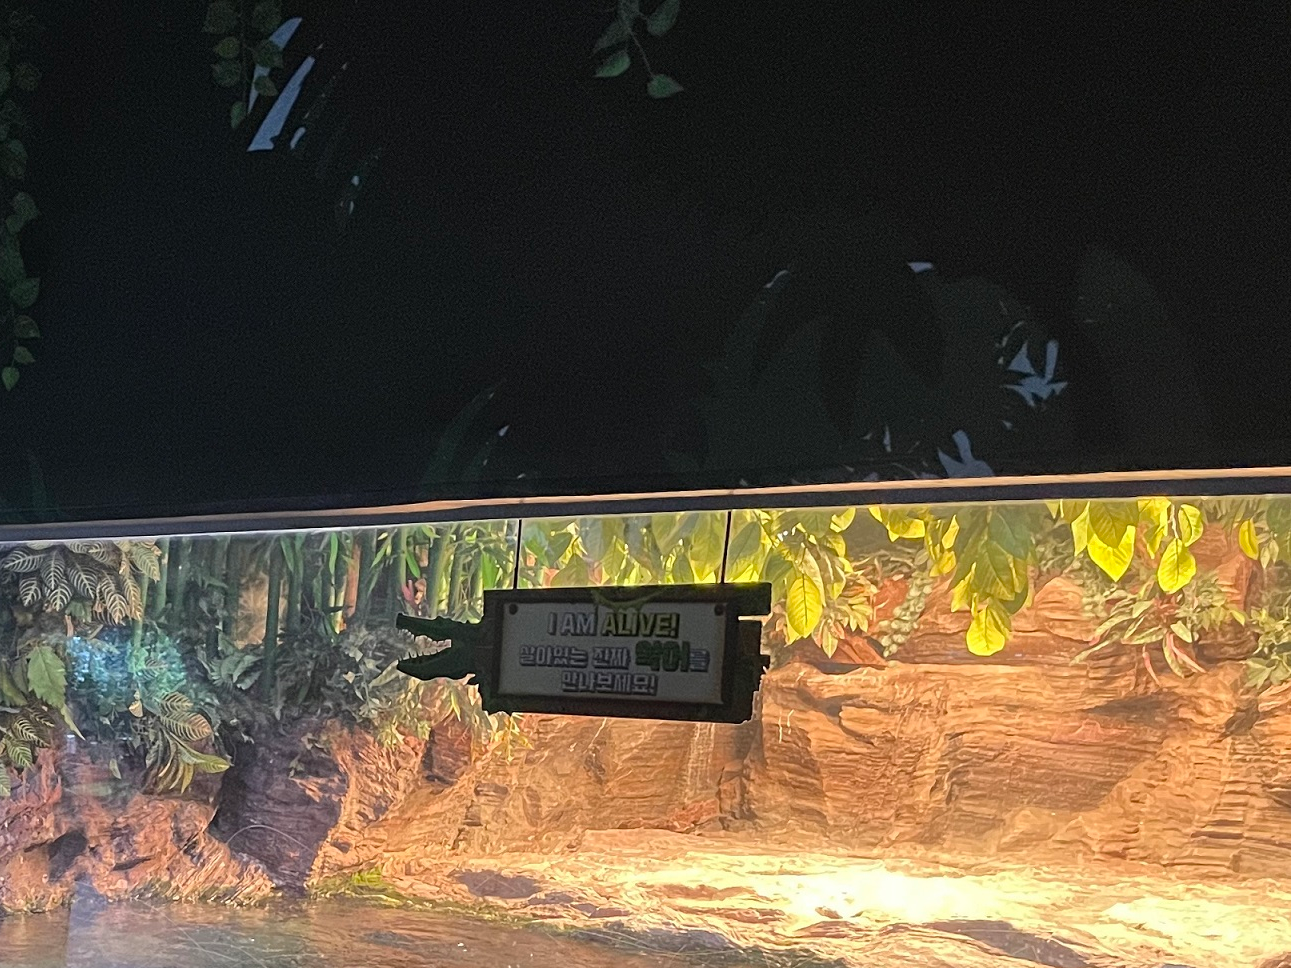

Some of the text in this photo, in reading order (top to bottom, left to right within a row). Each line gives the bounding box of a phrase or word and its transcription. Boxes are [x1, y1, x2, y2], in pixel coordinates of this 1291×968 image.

[548, 612, 680, 638] I AM ALIVE!
[520, 640, 710, 672] 살아있는 진짜 악어를
[561, 671, 658, 696] 만나보세요!
